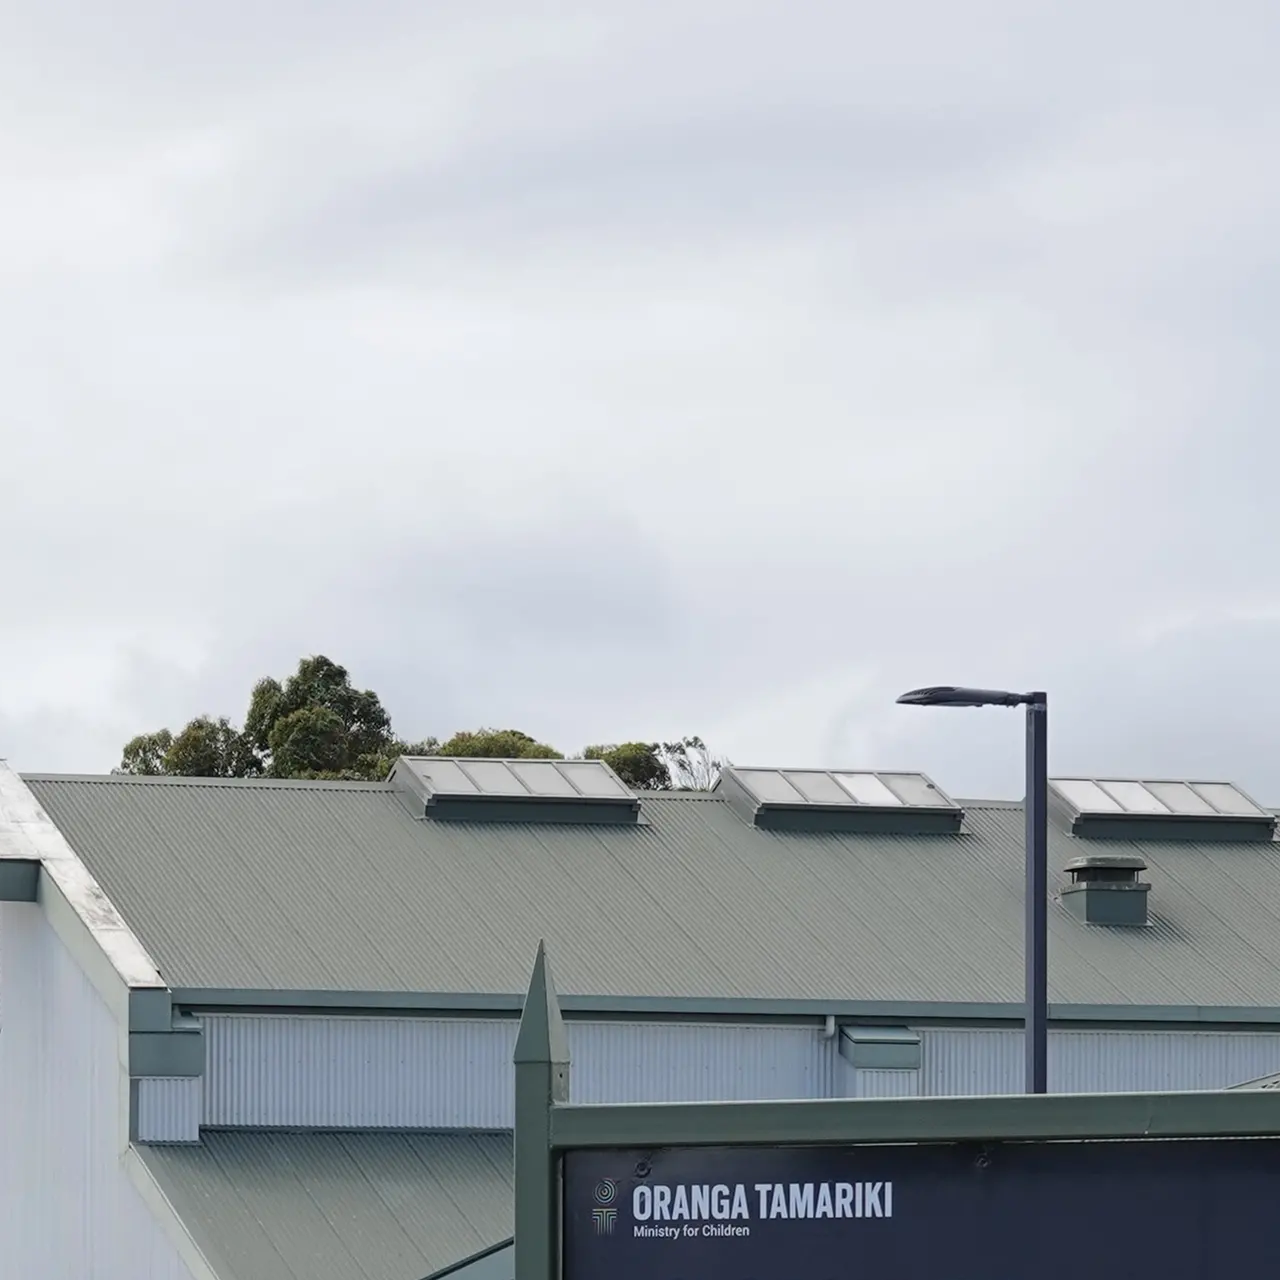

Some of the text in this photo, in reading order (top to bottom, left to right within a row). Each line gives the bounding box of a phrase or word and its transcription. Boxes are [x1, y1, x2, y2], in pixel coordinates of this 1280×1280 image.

[632, 1181, 893, 1221] ORANGA TAMARIKI
[633, 1223, 750, 1240] Ministry for Children
